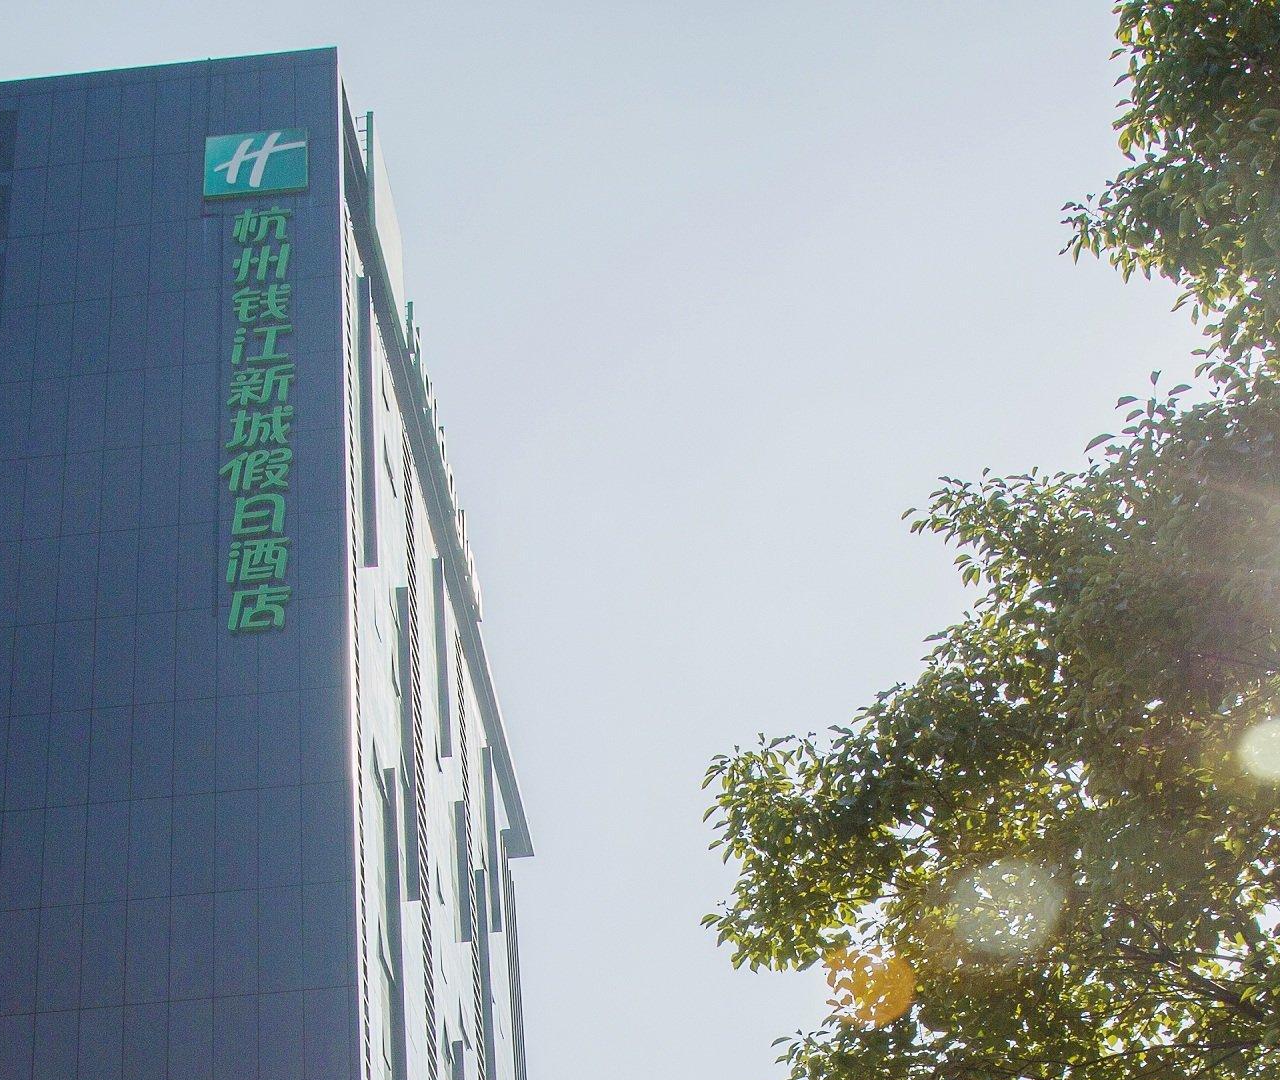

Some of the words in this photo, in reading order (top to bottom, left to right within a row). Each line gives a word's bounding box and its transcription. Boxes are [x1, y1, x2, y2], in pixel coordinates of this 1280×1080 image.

[220, 206, 295, 632] 杭州钱江新城假日酒店
